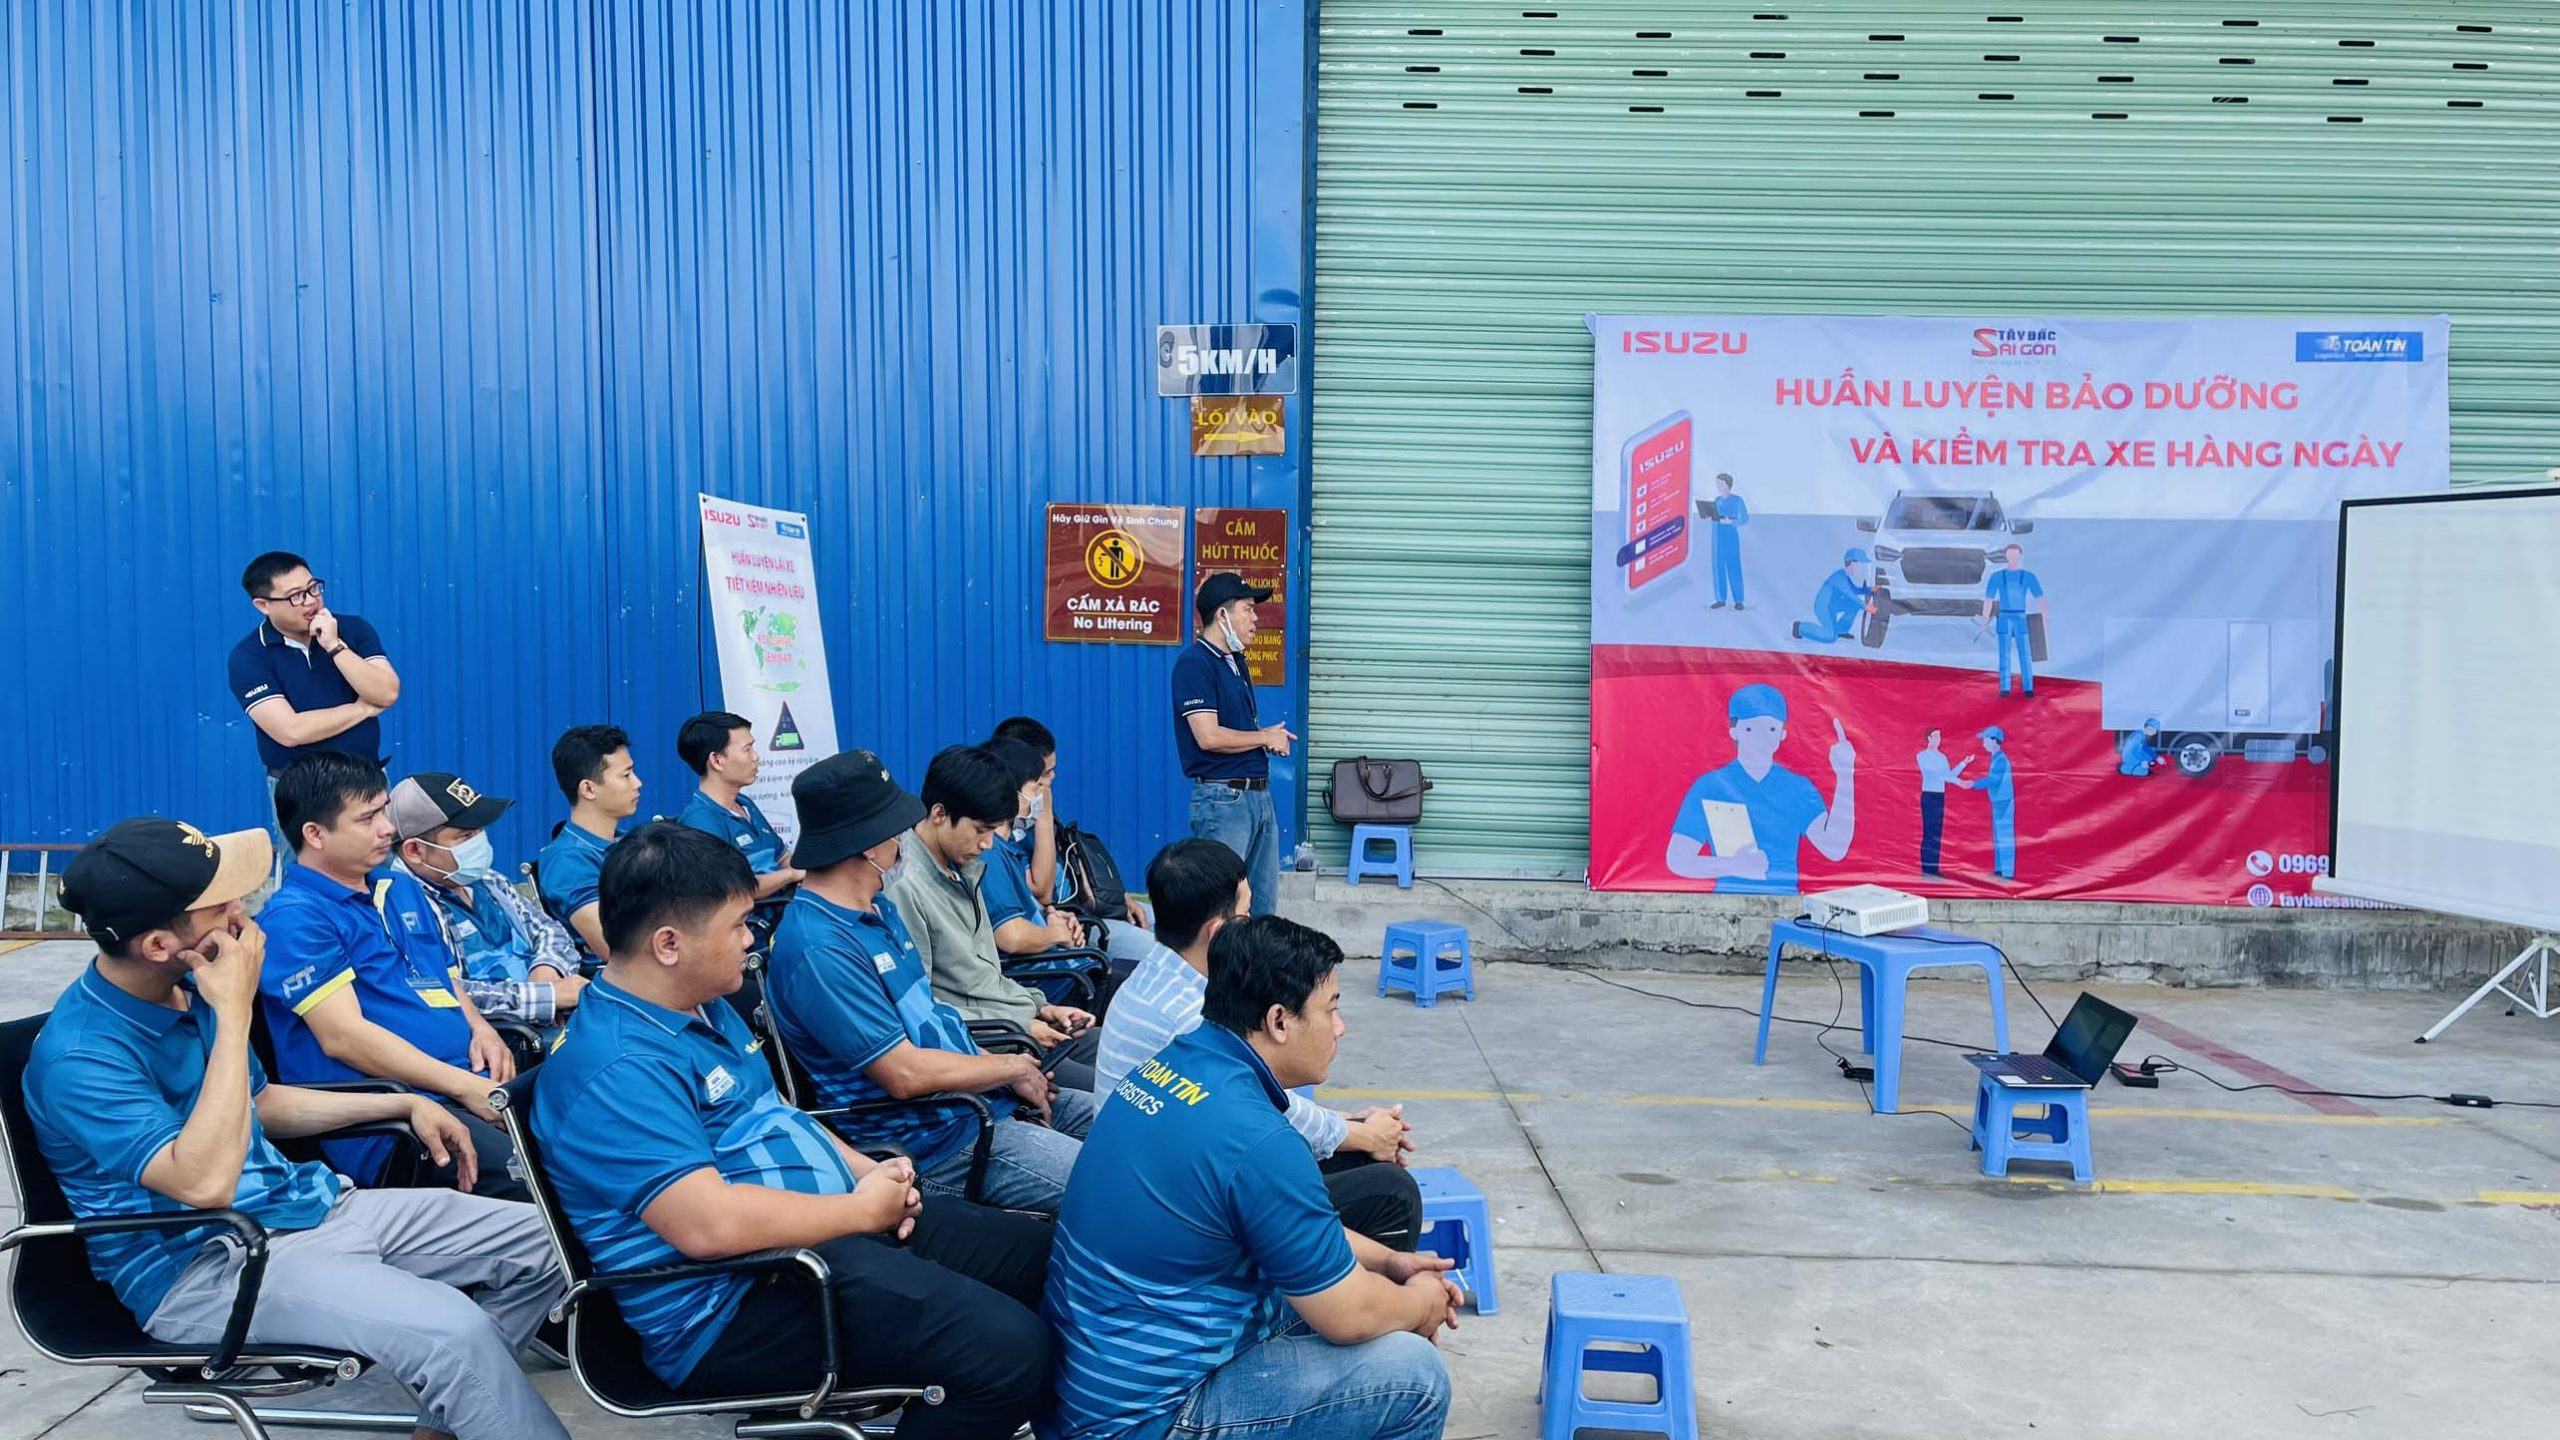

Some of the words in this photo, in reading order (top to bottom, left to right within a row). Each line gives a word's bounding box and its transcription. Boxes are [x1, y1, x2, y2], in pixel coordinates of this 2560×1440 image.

[1623, 331, 1748, 355] ISUZU
[1177, 344, 1277, 376] 5KM/H
[1776, 368, 1891, 408] HUẤN
[1902, 374, 2034, 418] LUYỆN
[2046, 373, 2133, 411] BẢO
[2145, 375, 2299, 411] DƯỠNG
[1234, 408, 1277, 426] VÀO
[1639, 440, 1685, 474] ISUZU
[1850, 432, 1901, 465] VÀ
[1912, 427, 2008, 466] KIỂM
[2018, 440, 2096, 467] TRA
[2106, 440, 2156, 468] XE
[2167, 434, 2282, 468] HÀNG
[2294, 434, 2403, 468] NGÀY
[704, 509, 740, 527] ISUZU
[1052, 513, 1072, 524] Hãy
[1092, 514, 1109, 524] Gìn
[1126, 515, 1145, 525] Sinh
[1147, 516, 1179, 528] Chung
[1225, 517, 1256, 536] CẤM
[1202, 542, 1229, 560] HÚT
[1232, 541, 1279, 560] THUỐC
[1067, 594, 1101, 611] CẤM
[1105, 595, 1126, 612] XẢ
[1129, 597, 1161, 613] RÁC
[1073, 616, 1094, 629] No
[1097, 617, 1153, 634] Littering
[2278, 854, 2330, 873] 0969
[1168, 1077, 1210, 1106] TÍN
